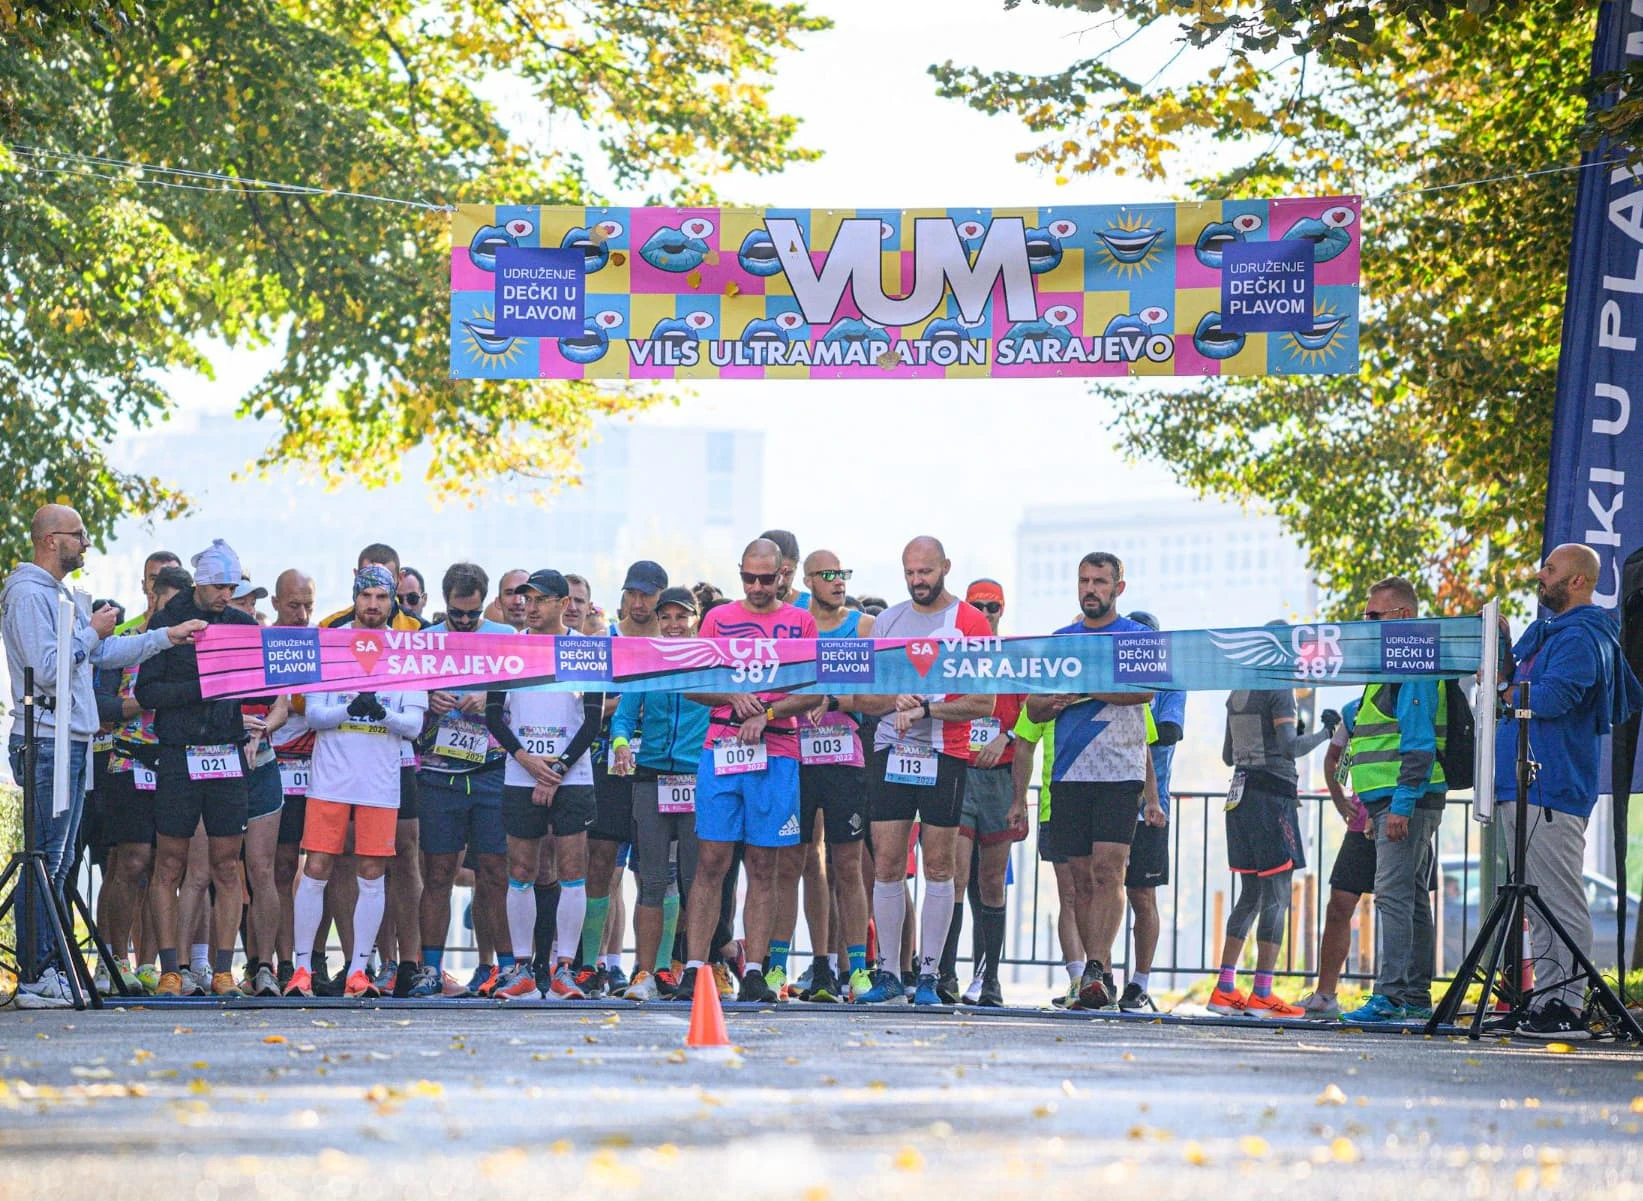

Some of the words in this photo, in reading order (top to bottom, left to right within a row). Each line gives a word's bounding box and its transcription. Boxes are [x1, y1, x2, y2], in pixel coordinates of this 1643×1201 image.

[503, 267, 576, 280] UDRUŽENJE
[763, 217, 1039, 326] VUM
[1230, 260, 1305, 274] UDRUŽENJE
[503, 282, 558, 300] DEČKI
[564, 286, 576, 301] U
[1230, 276, 1286, 295] DEČKI
[1293, 279, 1305, 294] U
[503, 305, 576, 320] PLAVOM
[1230, 299, 1305, 315] PLAVOM
[627, 338, 700, 367] VILS
[708, 338, 987, 367] ULTRAMARATON
[996, 334, 1176, 365] SARAJEVO
[1592, 383, 1630, 435] U
[267, 639, 315, 648] UDRUŽENJE
[355, 640, 378, 653] SA
[384, 631, 449, 651] VISIT
[941, 637, 1006, 652] VISIT
[1291, 625, 1343, 656] CR
[1386, 635, 1435, 645] UDRUŽENJE
[268, 648, 304, 661] DEČKI
[307, 649, 316, 660] U
[560, 648, 596, 660] DEČKI
[599, 650, 607, 660] U
[728, 638, 779, 659] CR
[821, 649, 857, 661] DEČKI
[861, 651, 869, 661] U
[911, 642, 934, 655] SA
[1118, 648, 1155, 660] DEČKI
[1158, 649, 1167, 660] U
[1386, 646, 1422, 658] DEČKI
[1426, 648, 1435, 658] U
[269, 662, 316, 674] PLAVOM
[387, 654, 525, 675] SARAJEVO
[560, 661, 608, 671] PLAVOM
[731, 659, 780, 684] 387
[821, 663, 870, 673] PLAVOM
[943, 656, 1083, 679] SARAJEVO
[1118, 662, 1167, 673] PLAVOM
[1293, 656, 1345, 680] 387
[1386, 660, 1435, 670] PLAVOM
[367, 725, 388, 734] 2022
[970, 729, 989, 742] 28
[449, 732, 475, 750] 241
[527, 740, 555, 754] 205
[813, 739, 842, 754] 003
[727, 748, 755, 764] 009
[201, 758, 227, 771] 021
[899, 759, 922, 774] 113
[294, 772, 308, 786] 01
